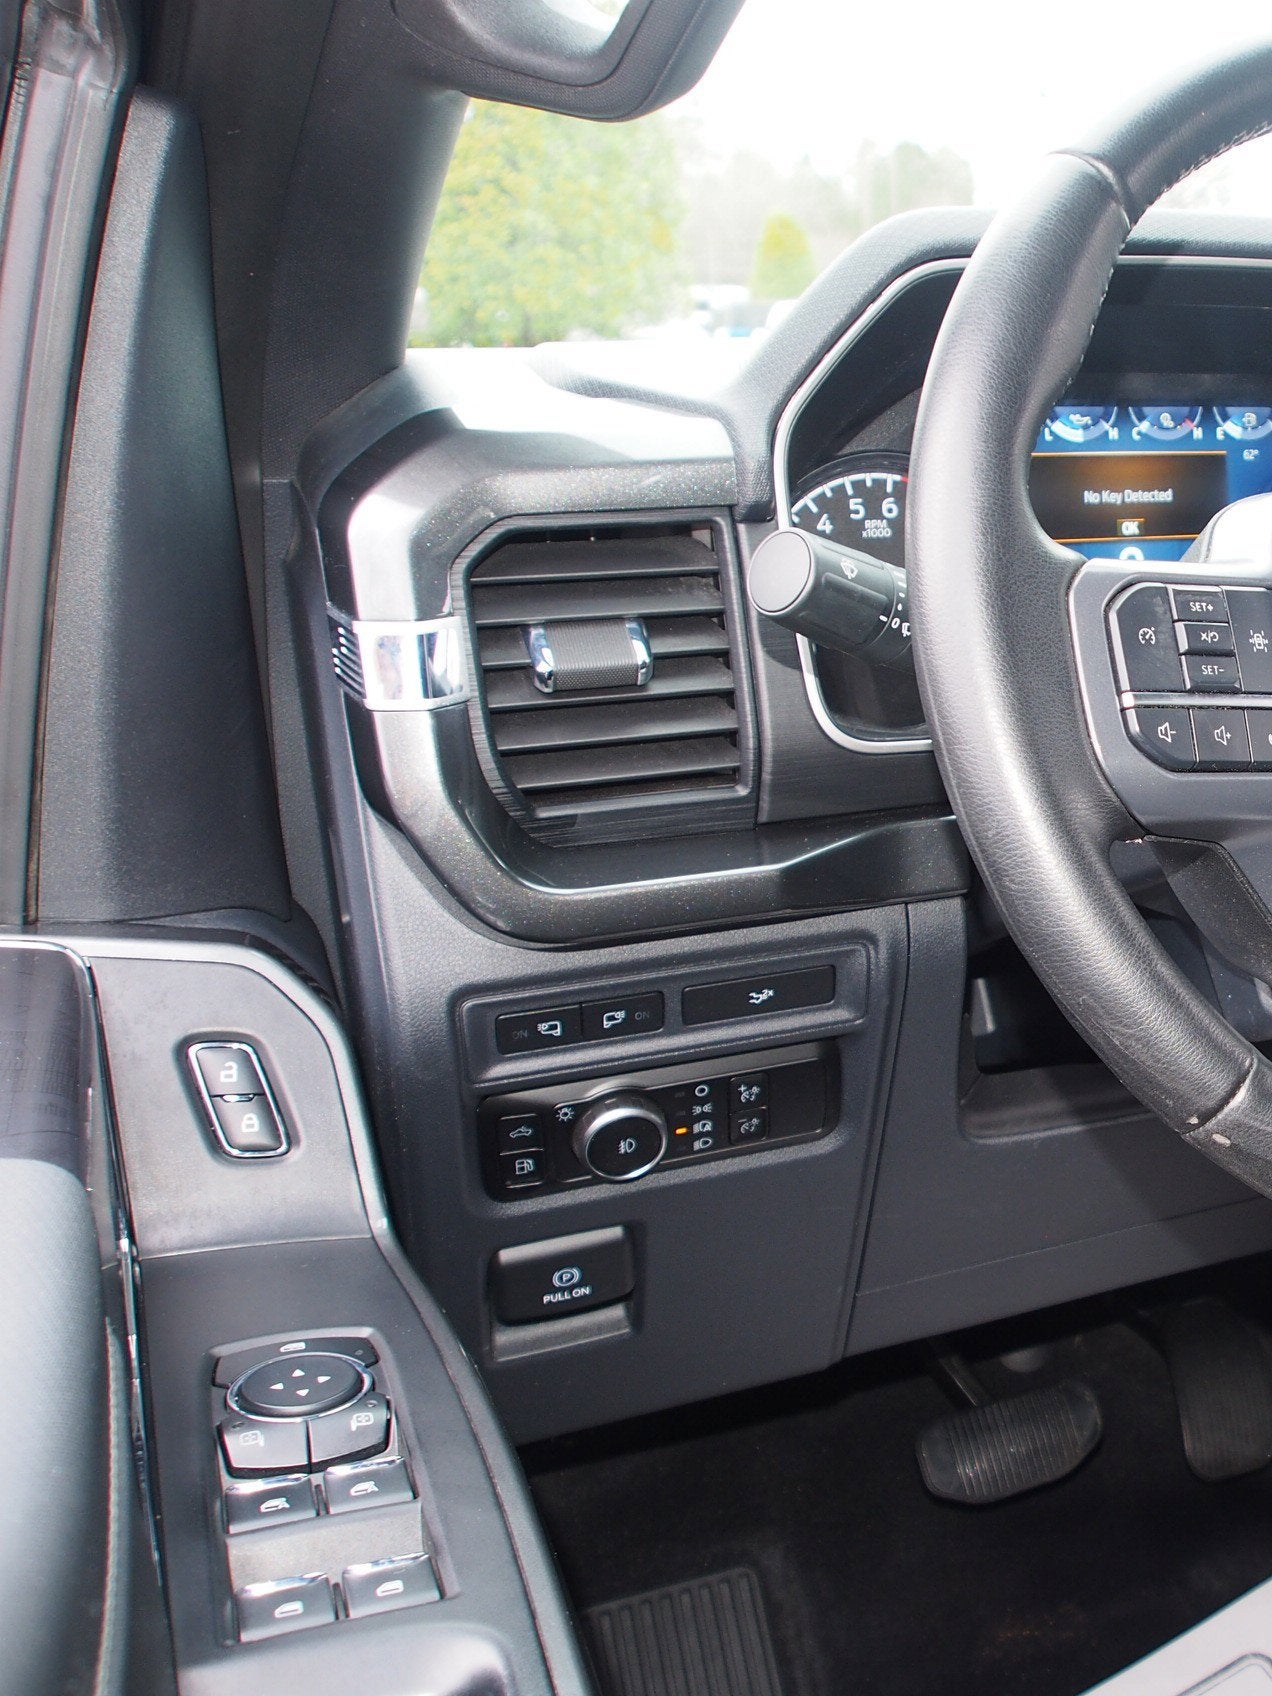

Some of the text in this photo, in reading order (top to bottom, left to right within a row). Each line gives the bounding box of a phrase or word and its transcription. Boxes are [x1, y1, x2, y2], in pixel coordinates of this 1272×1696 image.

[1083, 488, 1173, 505] No Key Detected
[850, 498, 865, 520] 5
[881, 497, 898, 518] 6
[816, 513, 833, 534] 4
[864, 519, 887, 529] RPM
[1121, 521, 1140, 536] OK
[634, 1011, 650, 1020] ON
[543, 1286, 590, 1305] PULL ON
